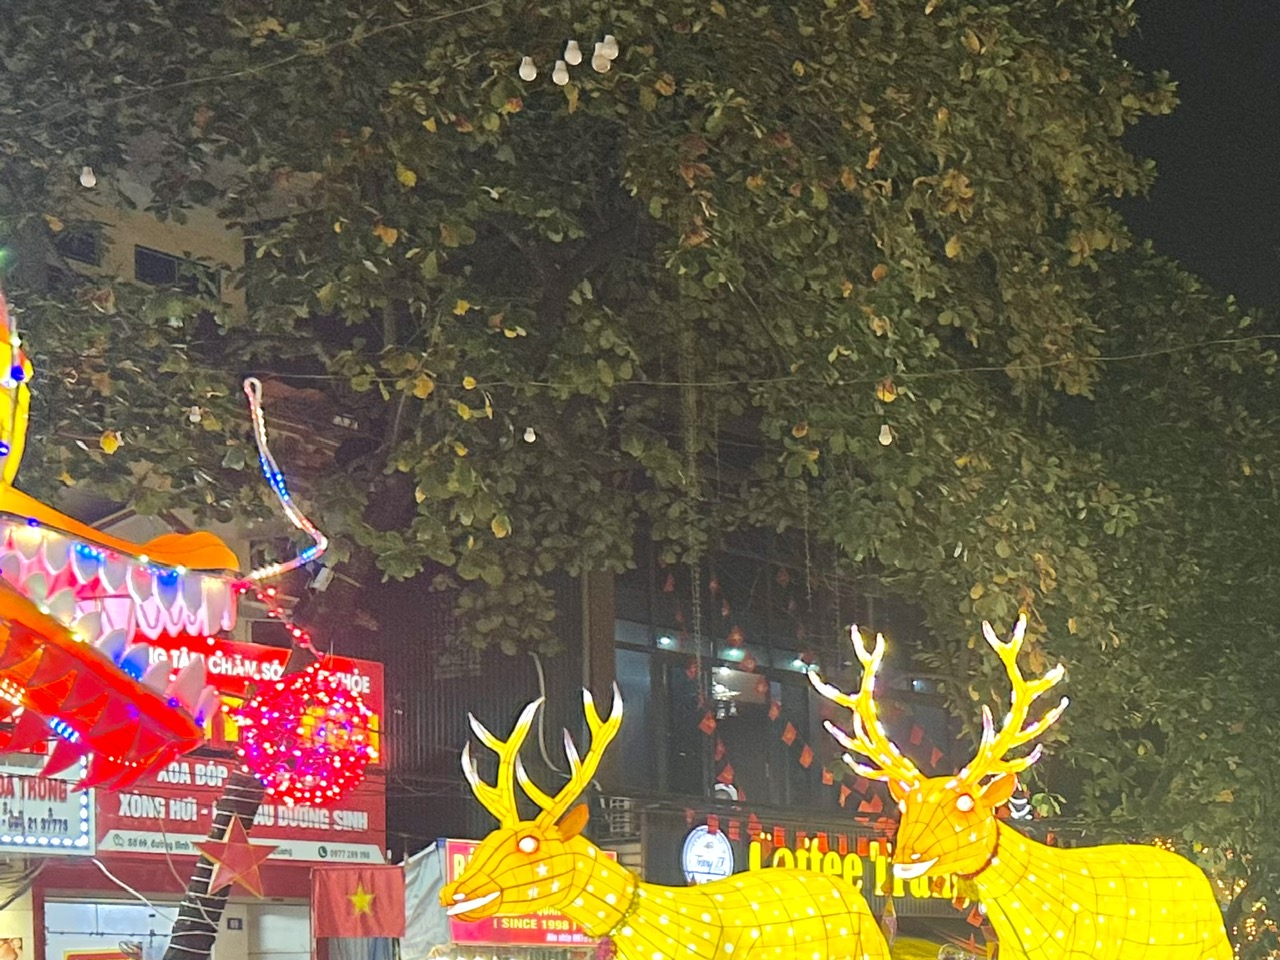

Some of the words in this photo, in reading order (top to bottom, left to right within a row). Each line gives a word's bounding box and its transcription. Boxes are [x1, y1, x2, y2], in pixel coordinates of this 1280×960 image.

[208, 655, 257, 677] CHĂM
[334, 668, 370, 694] HỎE
[195, 760, 228, 786] BÓP
[119, 790, 165, 819] XÔNG
[333, 810, 368, 831] SINH
